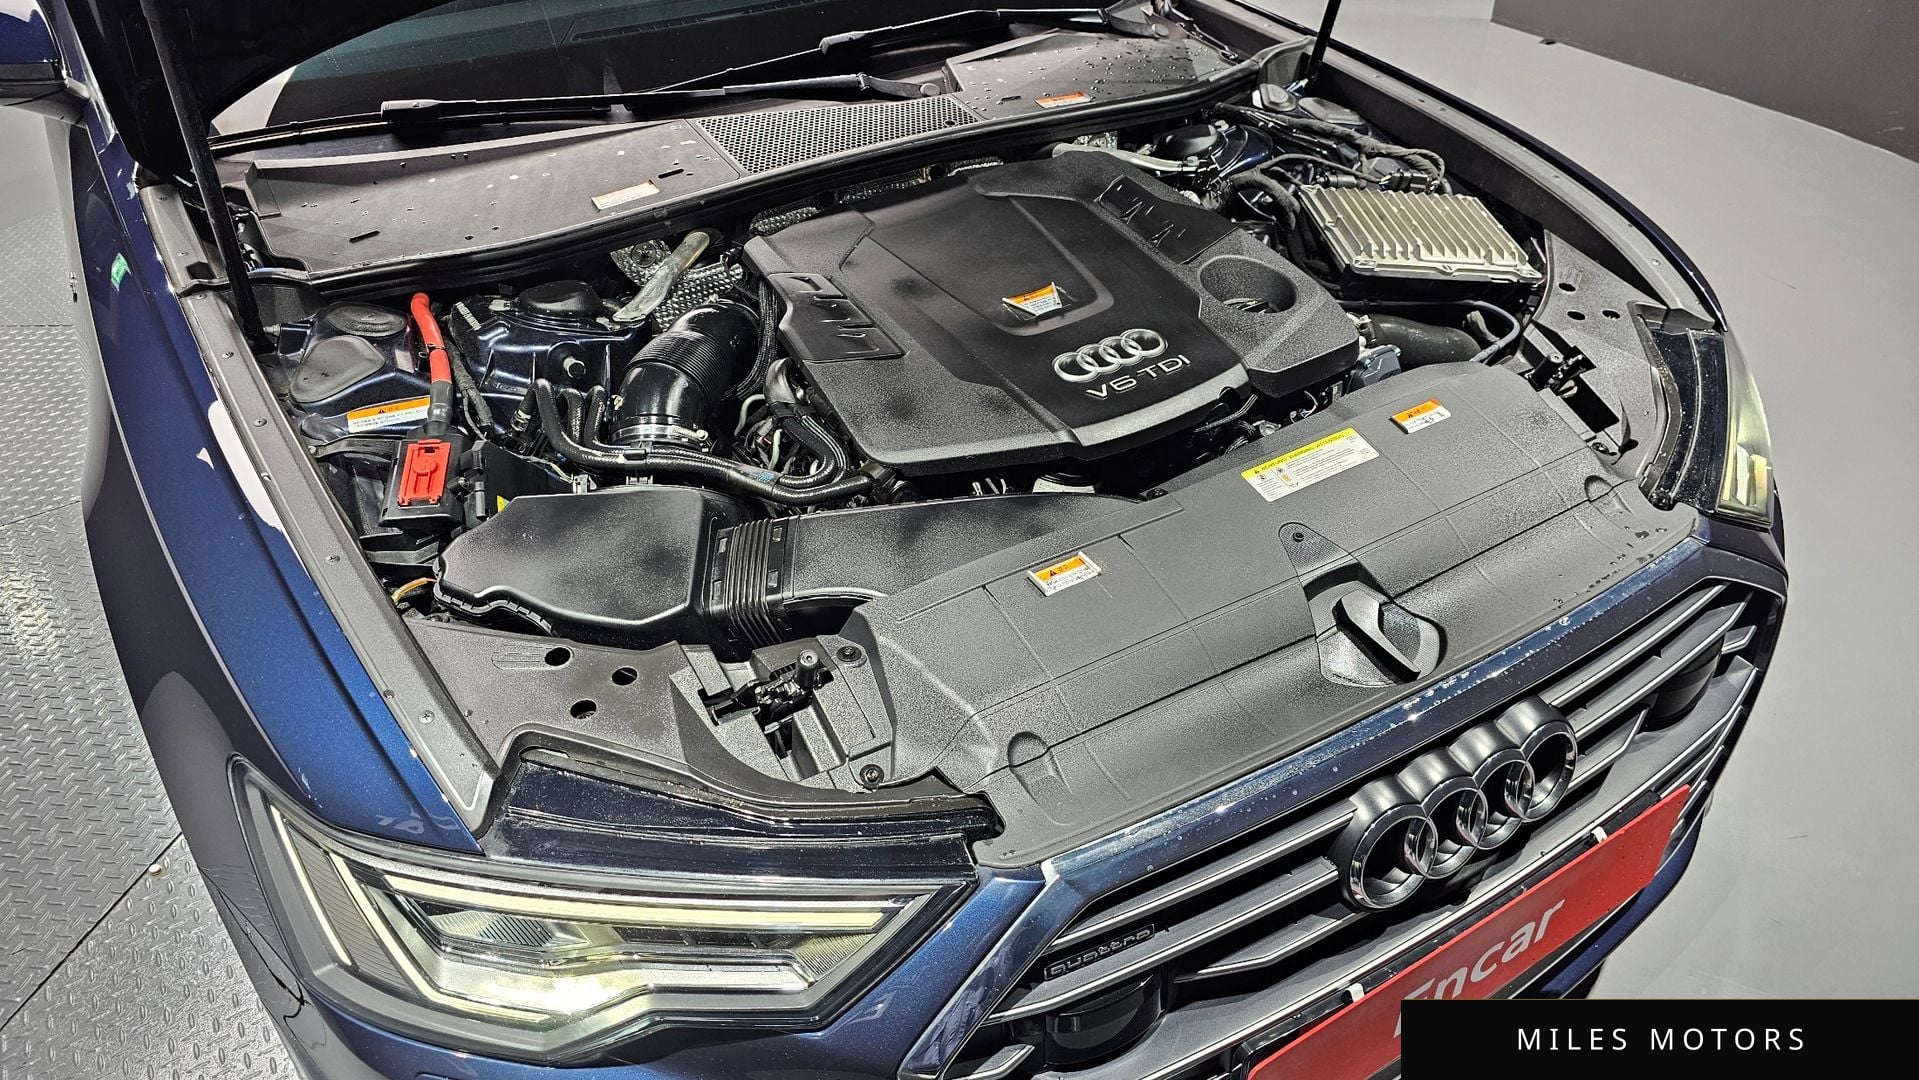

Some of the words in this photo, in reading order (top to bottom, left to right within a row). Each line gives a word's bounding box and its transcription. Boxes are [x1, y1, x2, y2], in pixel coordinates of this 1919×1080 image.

[1085, 375, 1137, 399] V6
[1137, 354, 1191, 379] TDI
[1050, 929, 1151, 976] quattro
